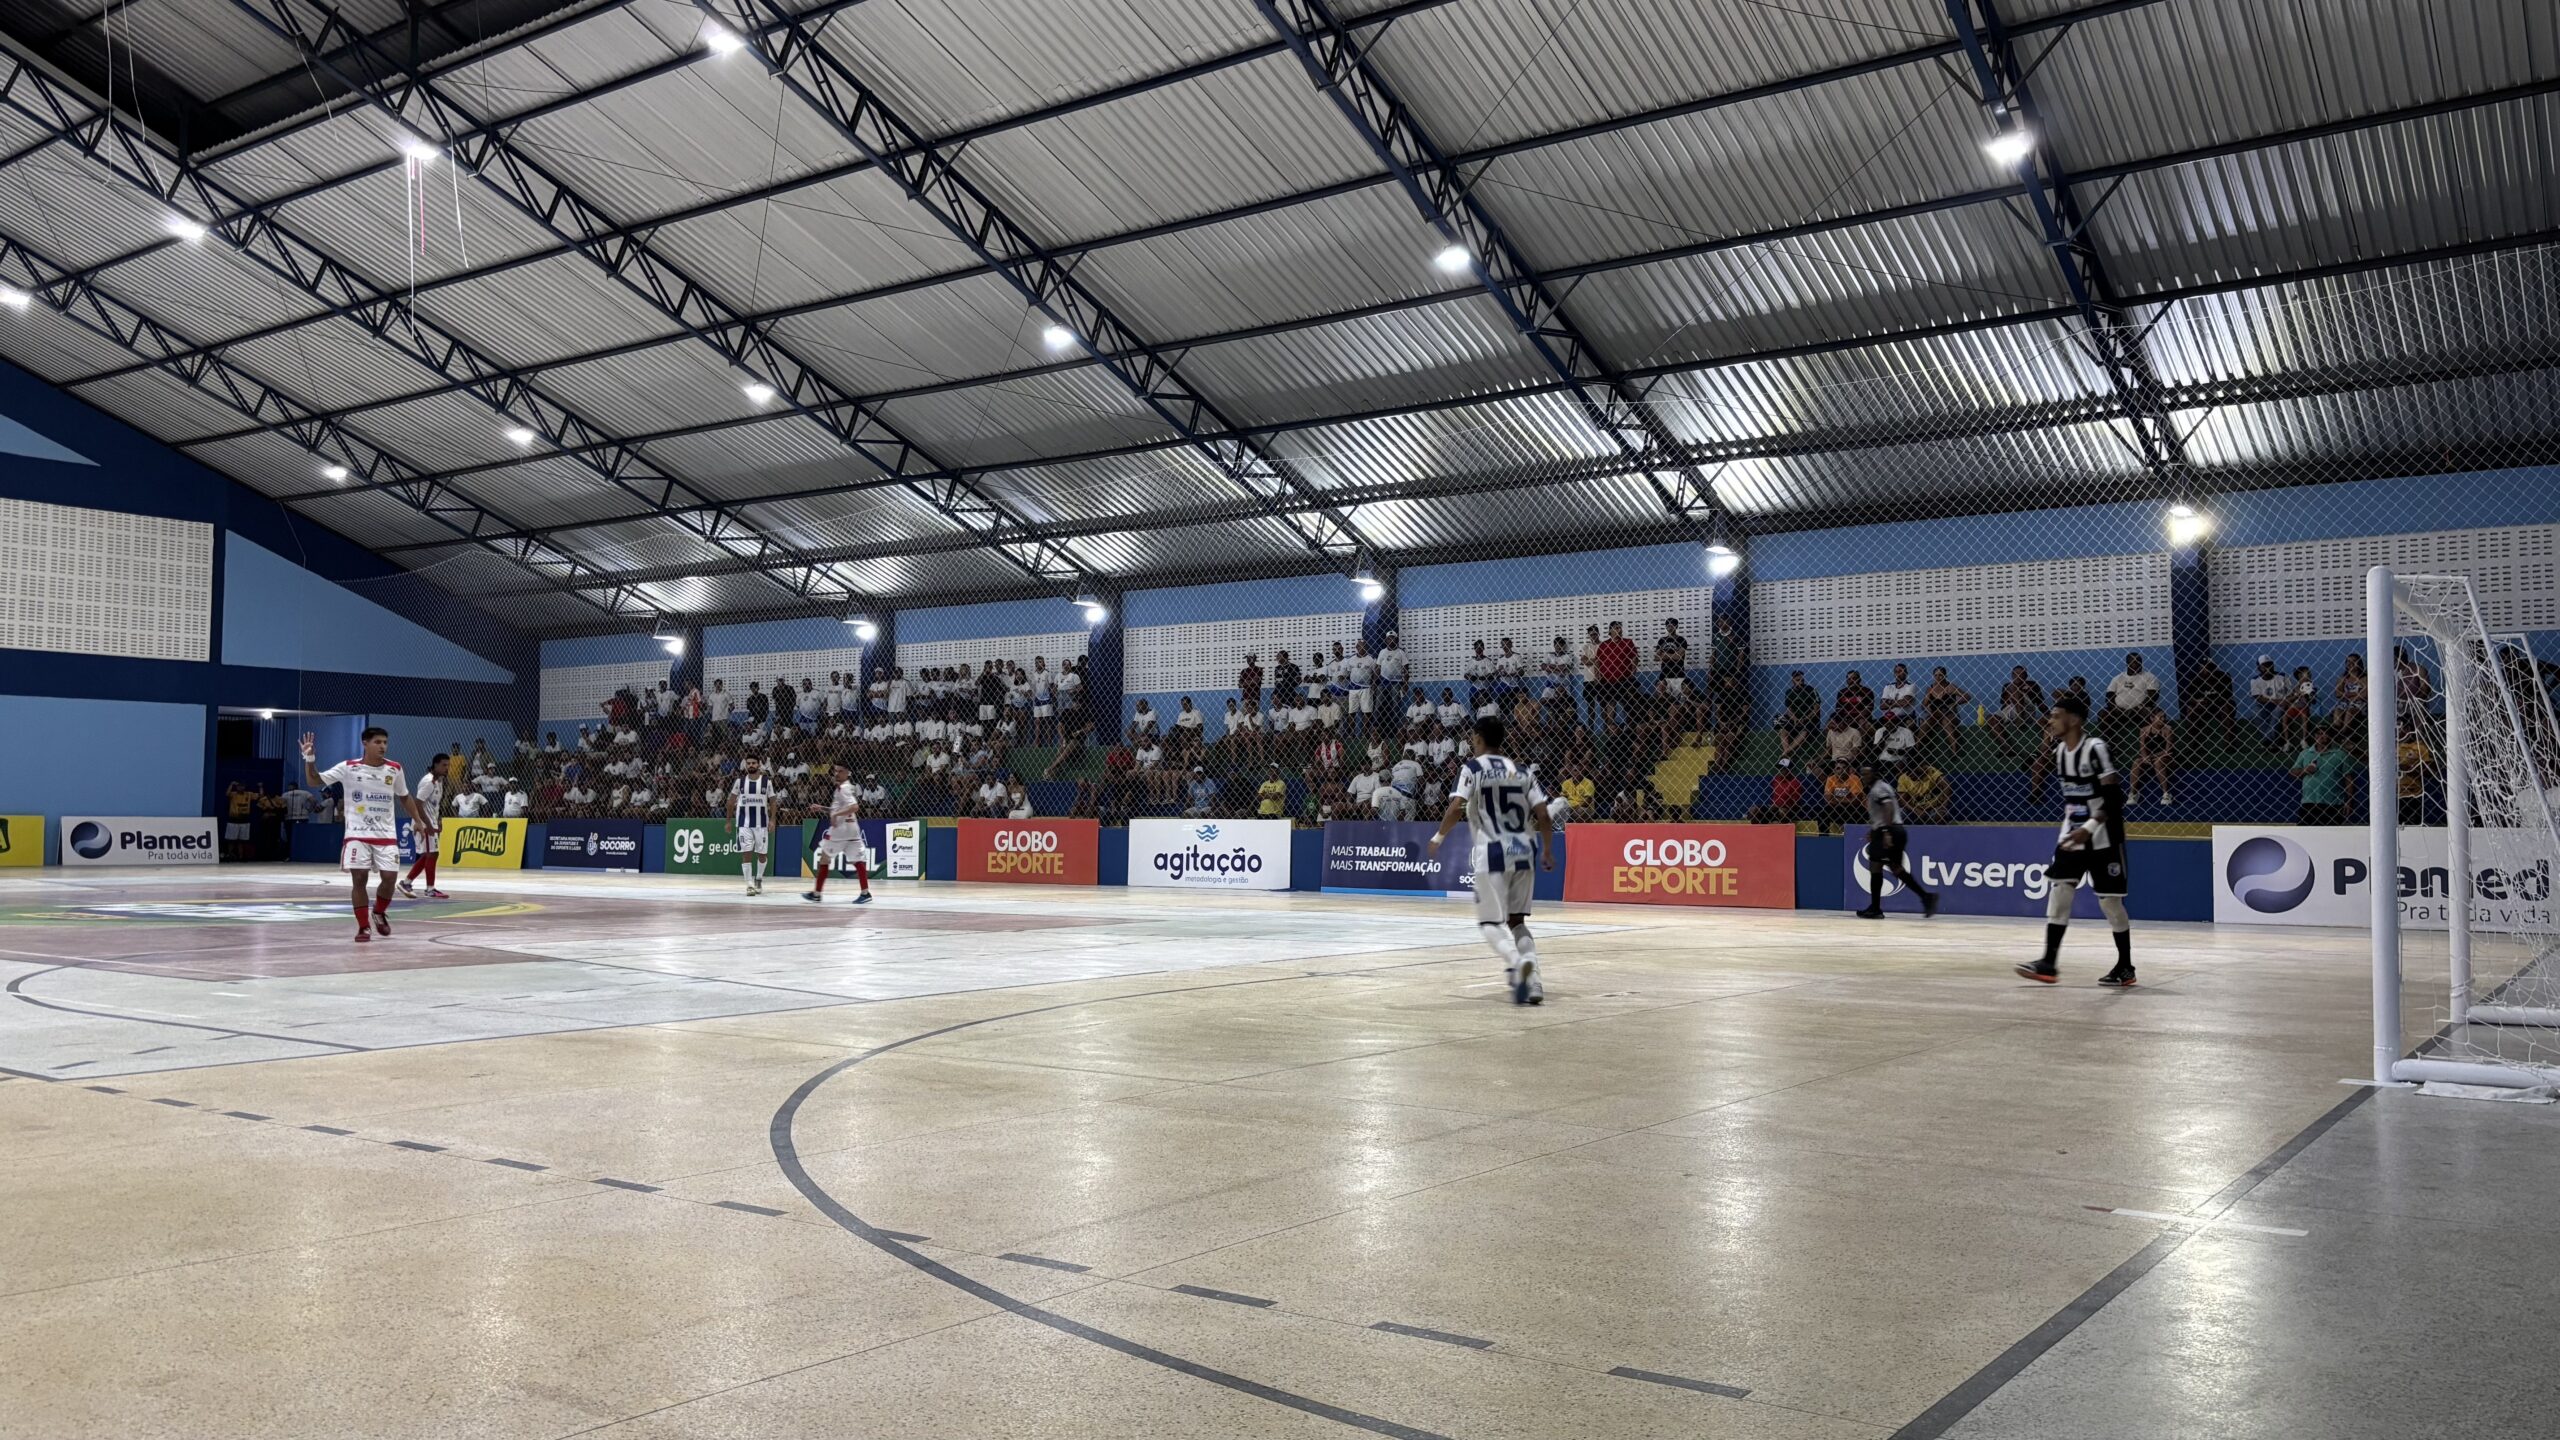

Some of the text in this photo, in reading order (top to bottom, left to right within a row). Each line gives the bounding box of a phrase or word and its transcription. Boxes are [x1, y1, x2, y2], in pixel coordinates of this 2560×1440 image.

[1481, 786, 1526, 833] 15
[120, 831, 211, 850] Plamed
[600, 841, 635, 851] SOCORRO
[673, 829, 704, 863] ge
[708, 840, 740, 855] ge.glo
[994, 830, 1058, 852] GLOBO
[148, 851, 213, 860] Pra toda vida
[352, 848, 357, 857] 9
[692, 855, 700, 864] SE
[1331, 845, 1408, 859] MAIS TRABALHO,
[1623, 838, 1727, 867] GLOBO
[987, 851, 1064, 875] ESPORTE
[1154, 844, 1262, 880] agitação
[1330, 859, 1441, 876] MAIS TRANSFORMAÇÃO
[1185, 875, 1222, 884] metodologia
[1228, 876, 1249, 885] gestão
[1613, 866, 1739, 896] ESPORTE
[2333, 857, 2550, 901] Pamed
[2437, 904, 2491, 923] tda
